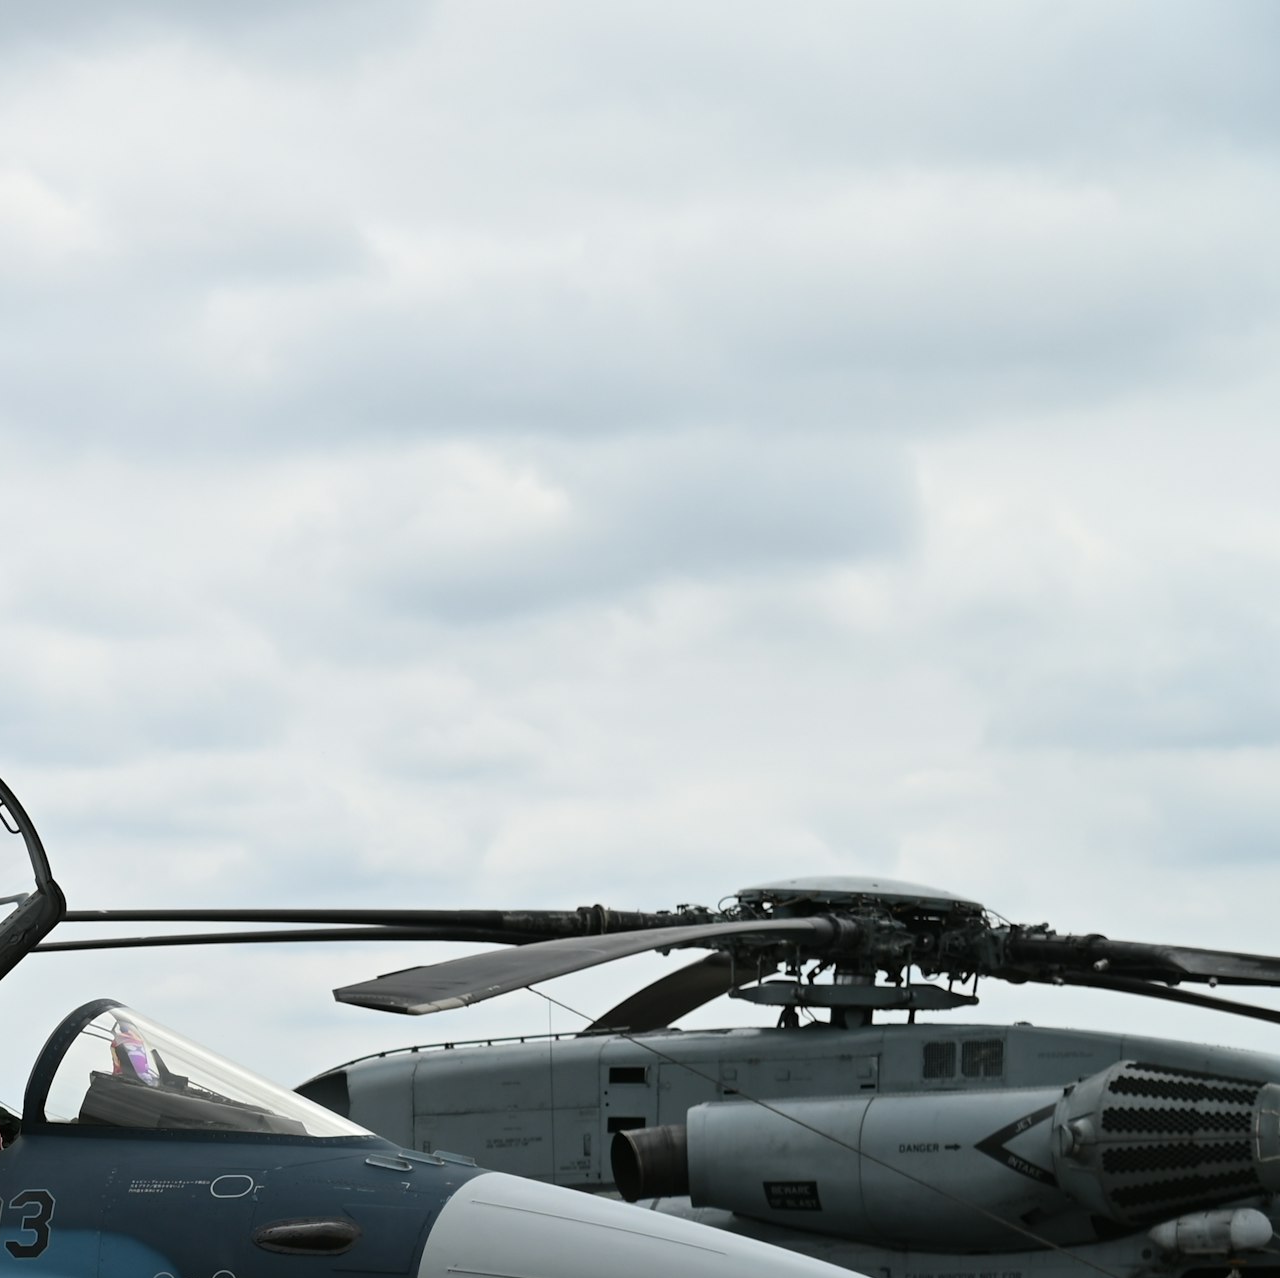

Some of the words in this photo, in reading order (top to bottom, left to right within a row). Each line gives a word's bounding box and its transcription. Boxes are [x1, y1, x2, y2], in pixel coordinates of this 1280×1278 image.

[1015, 1116, 1032, 1133] JET
[899, 1143, 939, 1154] DANGER
[1007, 1155, 1043, 1177] INTAKE
[771, 1184, 811, 1195] BEWARE
